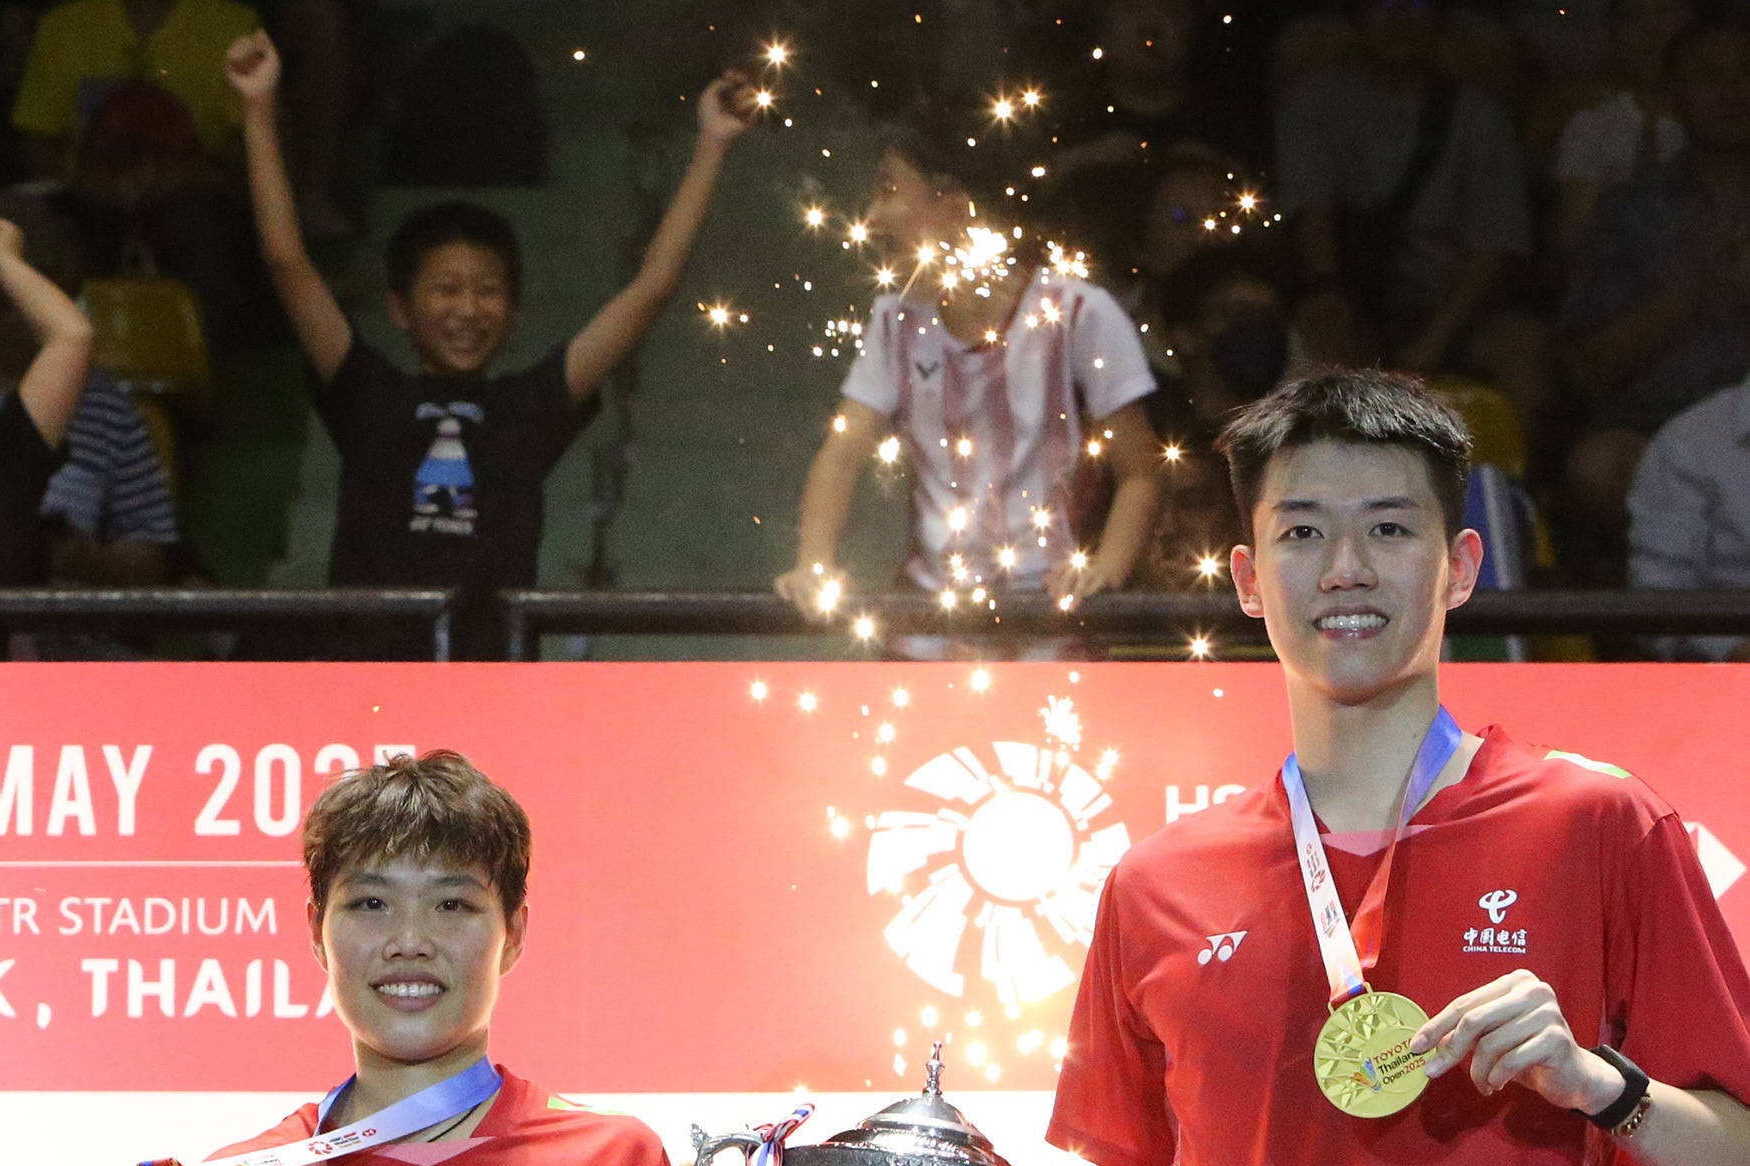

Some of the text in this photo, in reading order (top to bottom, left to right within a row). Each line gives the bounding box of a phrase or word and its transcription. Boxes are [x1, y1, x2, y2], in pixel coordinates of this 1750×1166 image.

[194, 743, 416, 837] 20
[58, 897, 277, 935] STADIUM
[1462, 945, 1527, 954] CHINA TELECOM
[1463, 927, 1528, 946] 中国电信
[1378, 1052, 1416, 1075] Thailan
[1382, 1056, 1427, 1085] Open 2025
